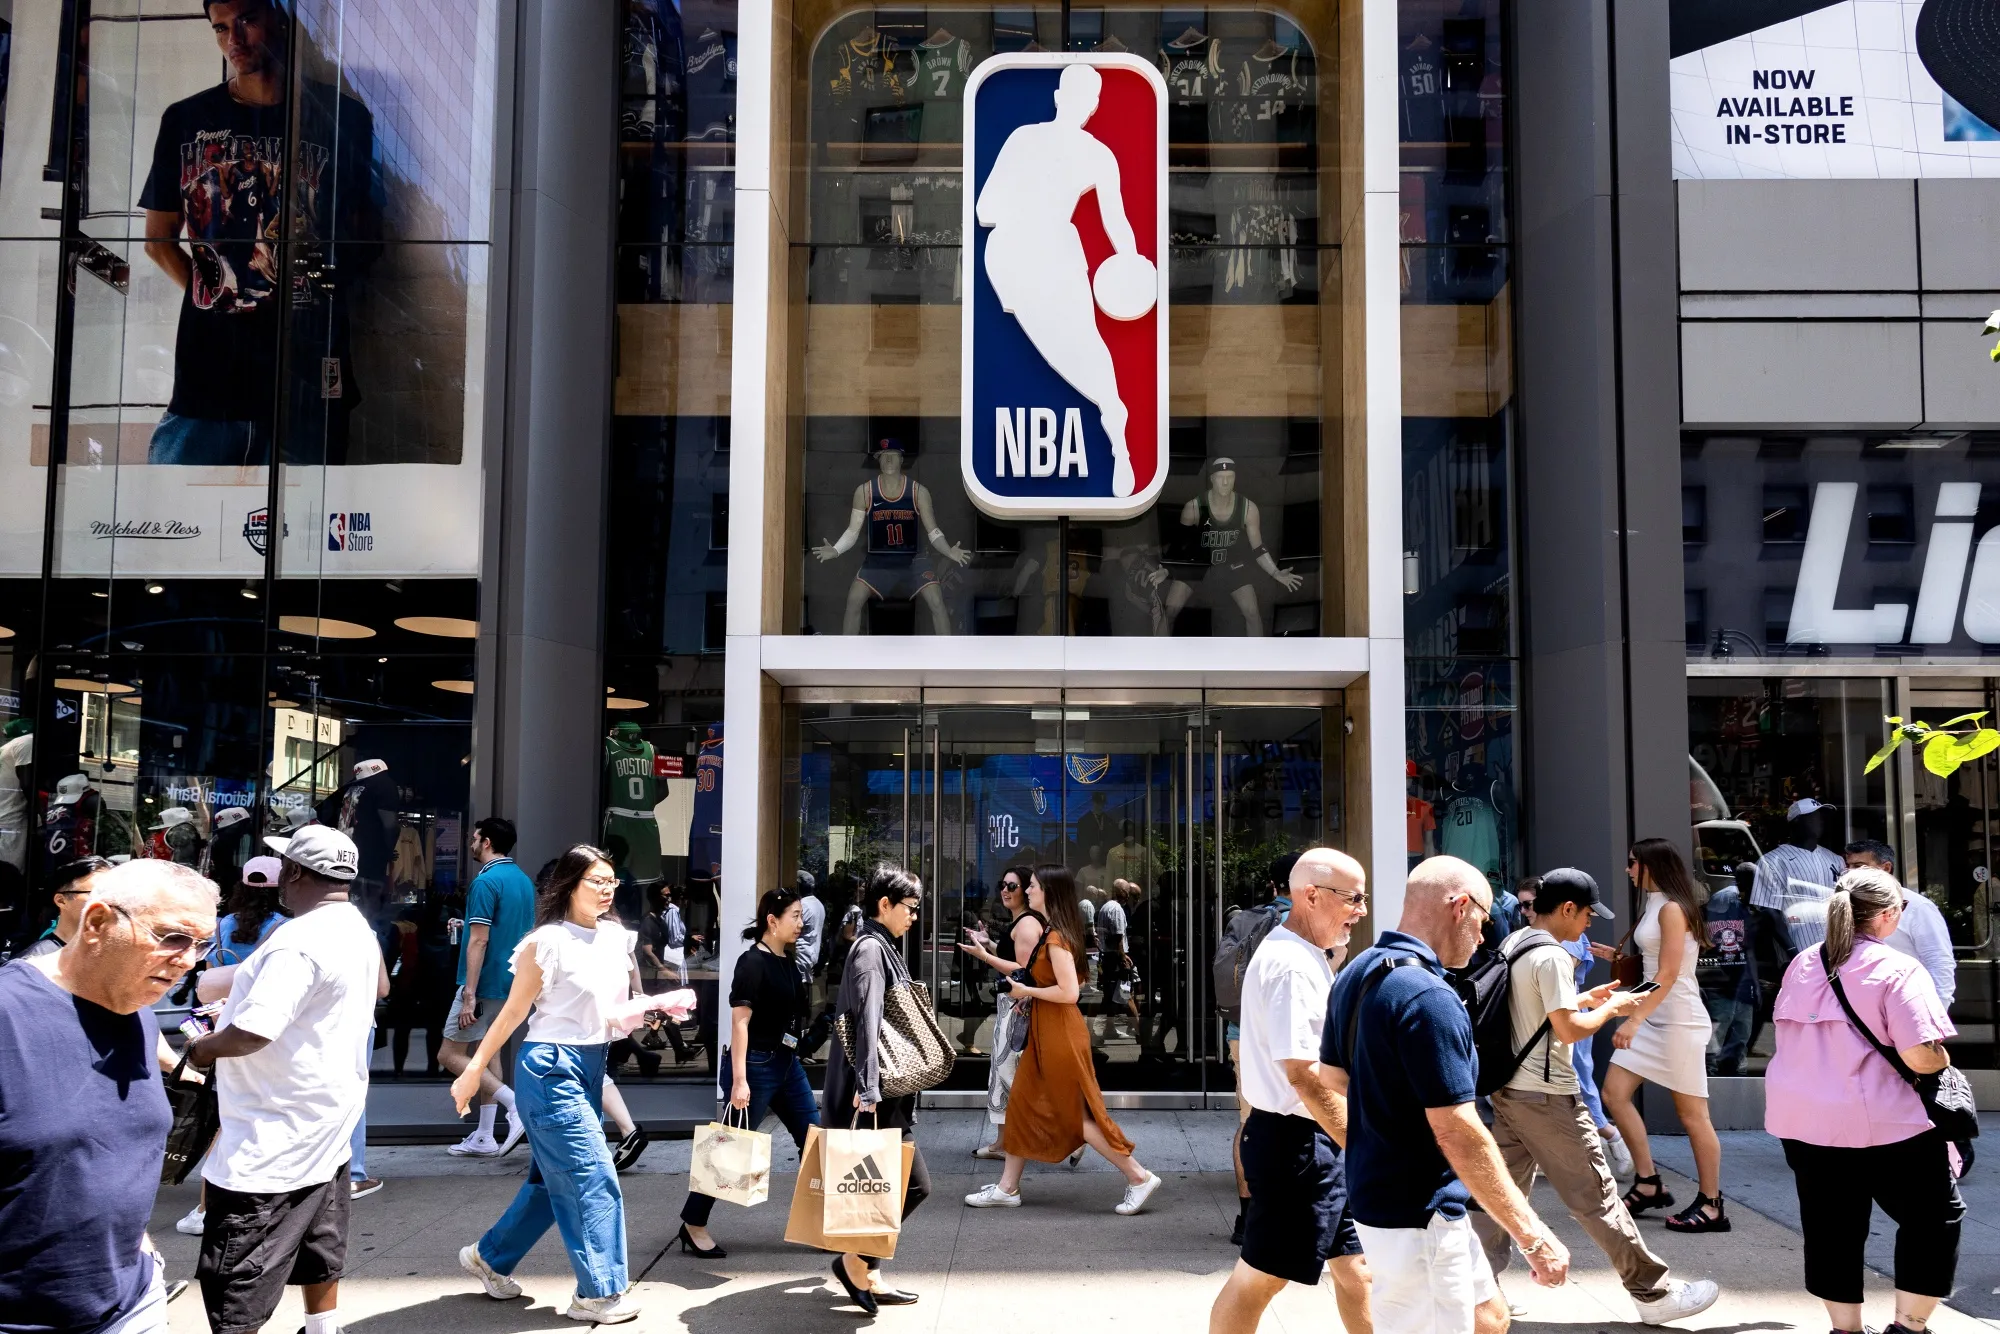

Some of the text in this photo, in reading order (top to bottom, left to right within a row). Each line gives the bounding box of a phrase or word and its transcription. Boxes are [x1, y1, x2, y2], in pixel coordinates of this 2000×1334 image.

[686, 43, 726, 68] Brooklyn
[926, 57, 952, 69] BROWN
[1409, 62, 1434, 74] ANTHONY
[931, 71, 949, 96] 7
[1411, 73, 1435, 96] 50
[1753, 69, 1815, 90] NOW
[1176, 76, 1203, 107] 34
[1716, 96, 1854, 117] AVAILABLE
[195, 129, 232, 143] Penny
[1726, 123, 1846, 145] IN-STORE
[248, 191, 257, 207] 6
[995, 407, 1089, 478] NBA
[251, 514, 269, 528] US
[350, 513, 371, 531] NBA
[873, 509, 914, 521] NEW YORK
[91, 519, 201, 536] Mitchell & Ness
[886, 523, 904, 546] 11
[348, 532, 374, 552] Store
[1201, 529, 1240, 548] CELTICS
[1211, 549, 1227, 565] 0
[1460, 684, 1483, 706] DETROIT
[1460, 702, 1484, 726] PISTONS
[616, 758, 653, 778] BOSTON
[628, 777, 645, 799] 0
[697, 768, 715, 792] 30
[1456, 810, 1473, 826] 20
[49, 829, 67, 854] 6
[336, 849, 356, 866] NETS
[837, 1179, 891, 1194] adidas
